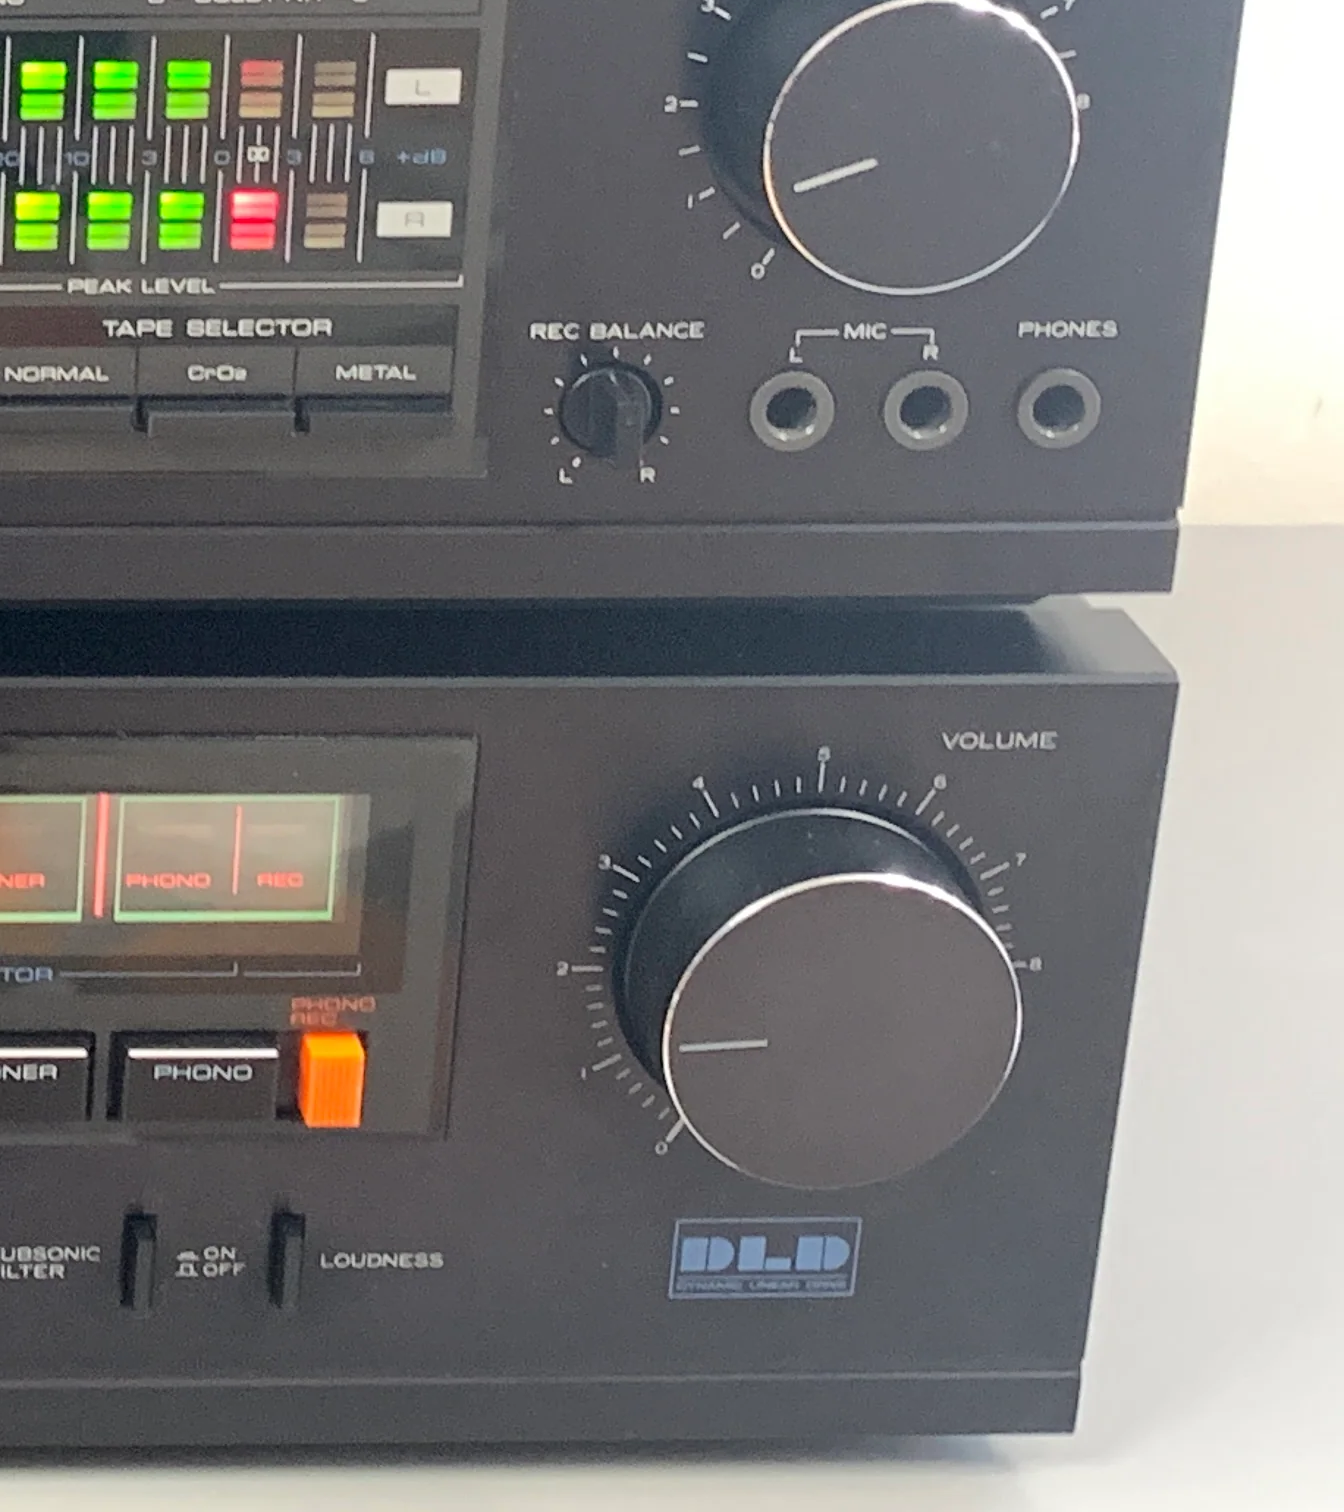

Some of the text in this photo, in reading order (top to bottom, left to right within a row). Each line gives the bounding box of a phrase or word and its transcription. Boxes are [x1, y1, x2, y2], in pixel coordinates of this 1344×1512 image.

[68, 278, 215, 294] PEAK LEVEL
[103, 319, 332, 337] TAPE SELECTOR
[531, 322, 704, 340] REC BALANCE
[844, 323, 886, 339] MIC
[1019, 320, 1117, 338] PHONES
[5, 366, 109, 382] NORMAL
[336, 365, 416, 380] METAL
[942, 732, 1057, 750] VOLUME
[126, 873, 211, 888] PHONO
[154, 1064, 252, 1081] PHONO
[204, 1246, 235, 1261] ON
[321, 1252, 443, 1268] LOUDNESS
[681, 1236, 849, 1272] DLD
[203, 1263, 245, 1277] OFF
